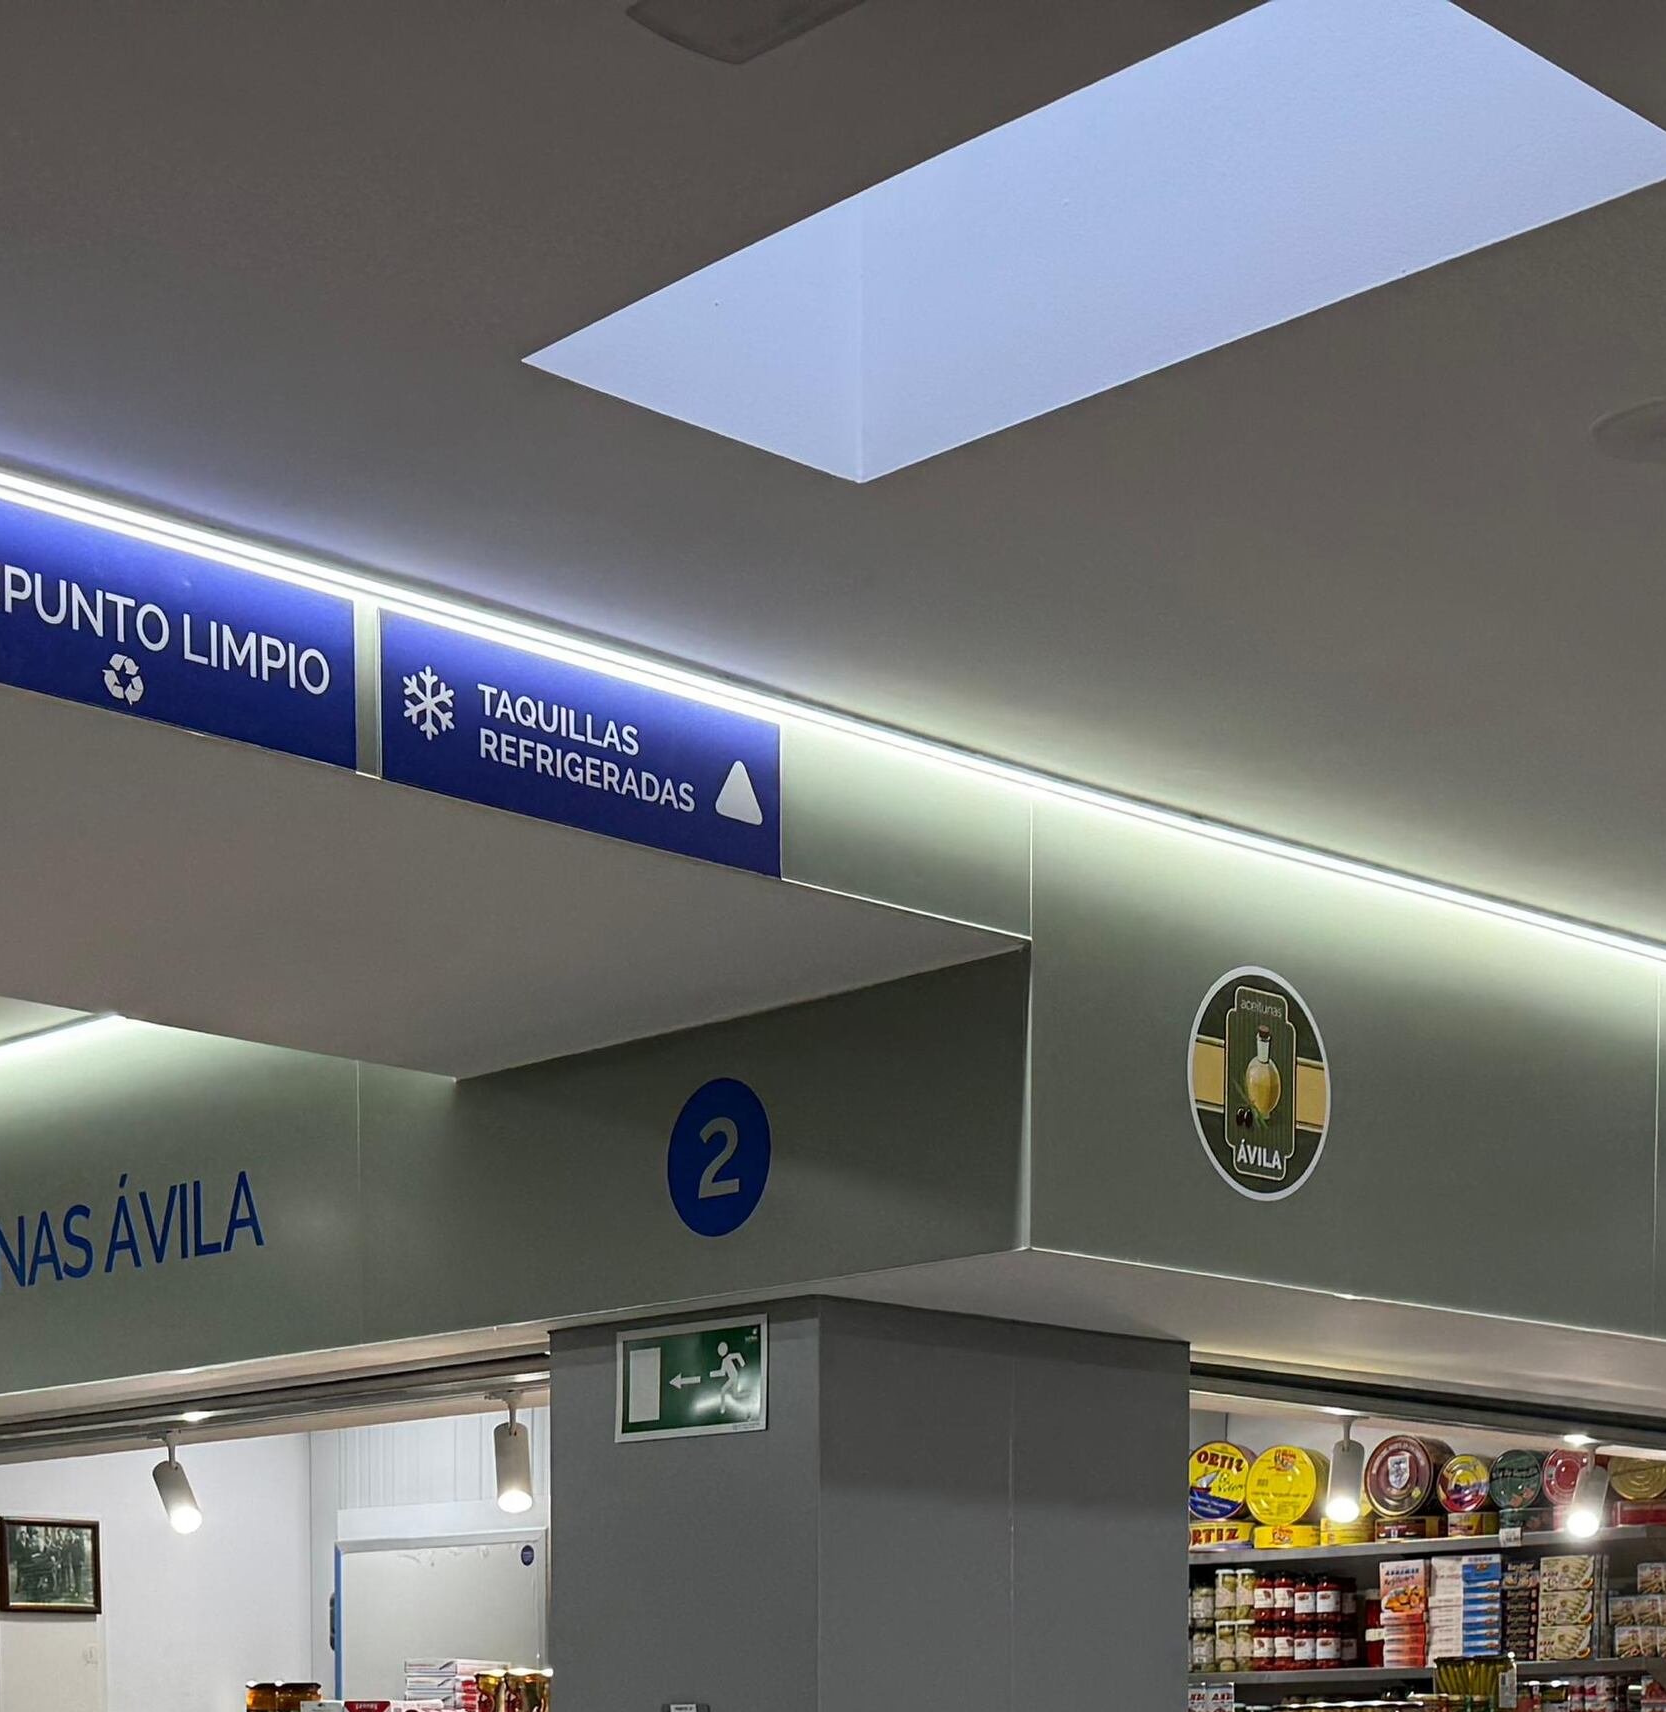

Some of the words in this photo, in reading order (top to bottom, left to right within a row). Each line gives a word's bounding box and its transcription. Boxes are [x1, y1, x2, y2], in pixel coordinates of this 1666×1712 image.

[183, 613, 331, 697] LIMPIO
[477, 683, 640, 756] TAQUILLAS
[480, 727, 696, 812] REFRIGERADAS
[1240, 997, 1282, 1018] aceitunas
[698, 1116, 740, 1199] 2
[1237, 1138, 1282, 1170] ÁVILA
[103, 1171, 265, 1274] ÁVILA
[1197, 1450, 1244, 1473] ORTIZ
[1190, 1527, 1239, 1546] RTIZ
